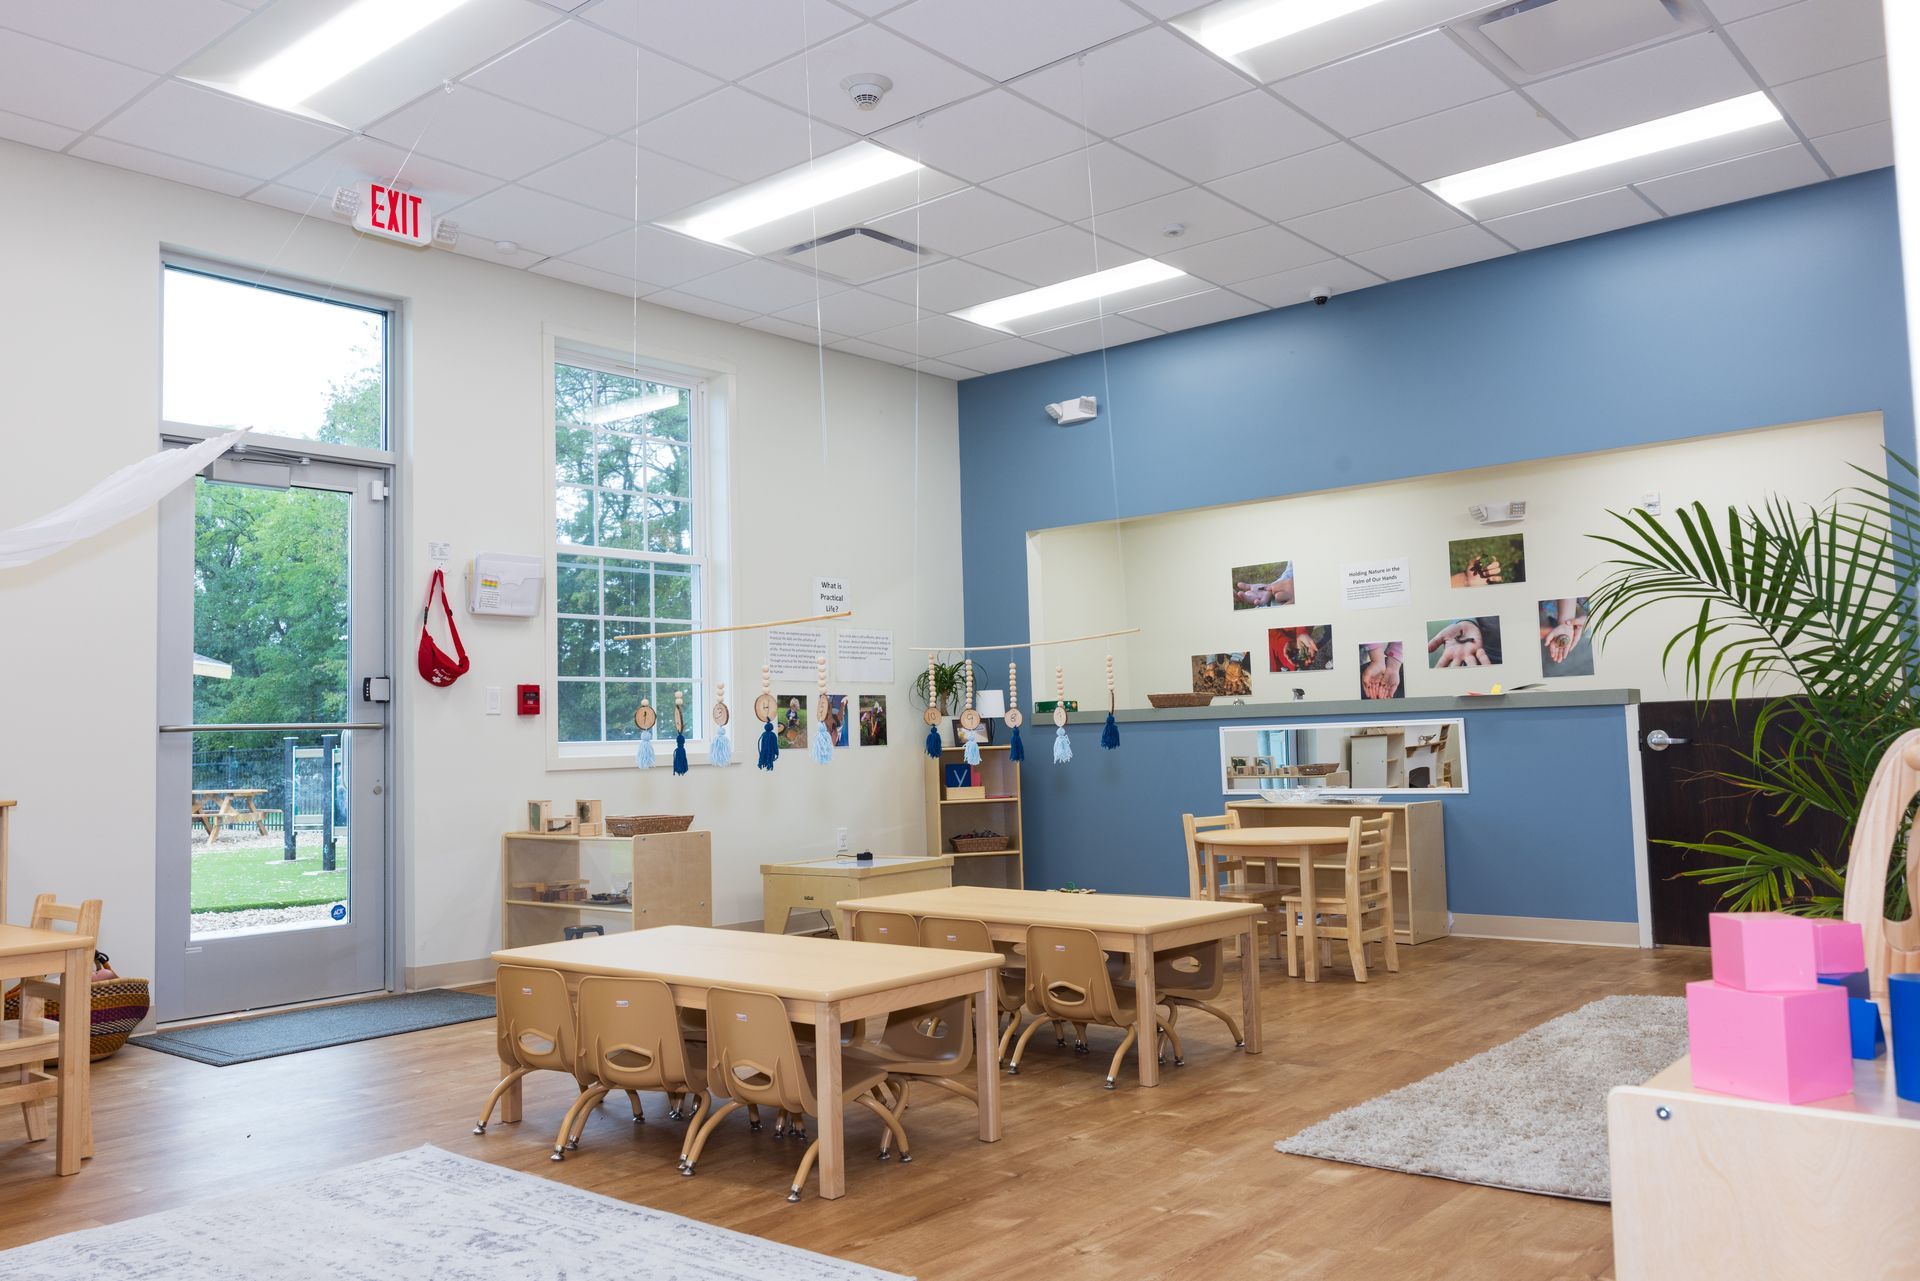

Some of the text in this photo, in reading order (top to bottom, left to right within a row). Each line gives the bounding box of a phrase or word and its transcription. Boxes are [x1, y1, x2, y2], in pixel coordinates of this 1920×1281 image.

[371, 183, 422, 238] EXIT
[821, 581, 842, 590] What is
[820, 593, 844, 602] Practical
[825, 605, 839, 613] Life?
[927, 711, 936, 721] 10
[967, 713, 974, 726] 9
[1010, 713, 1017, 723] 8
